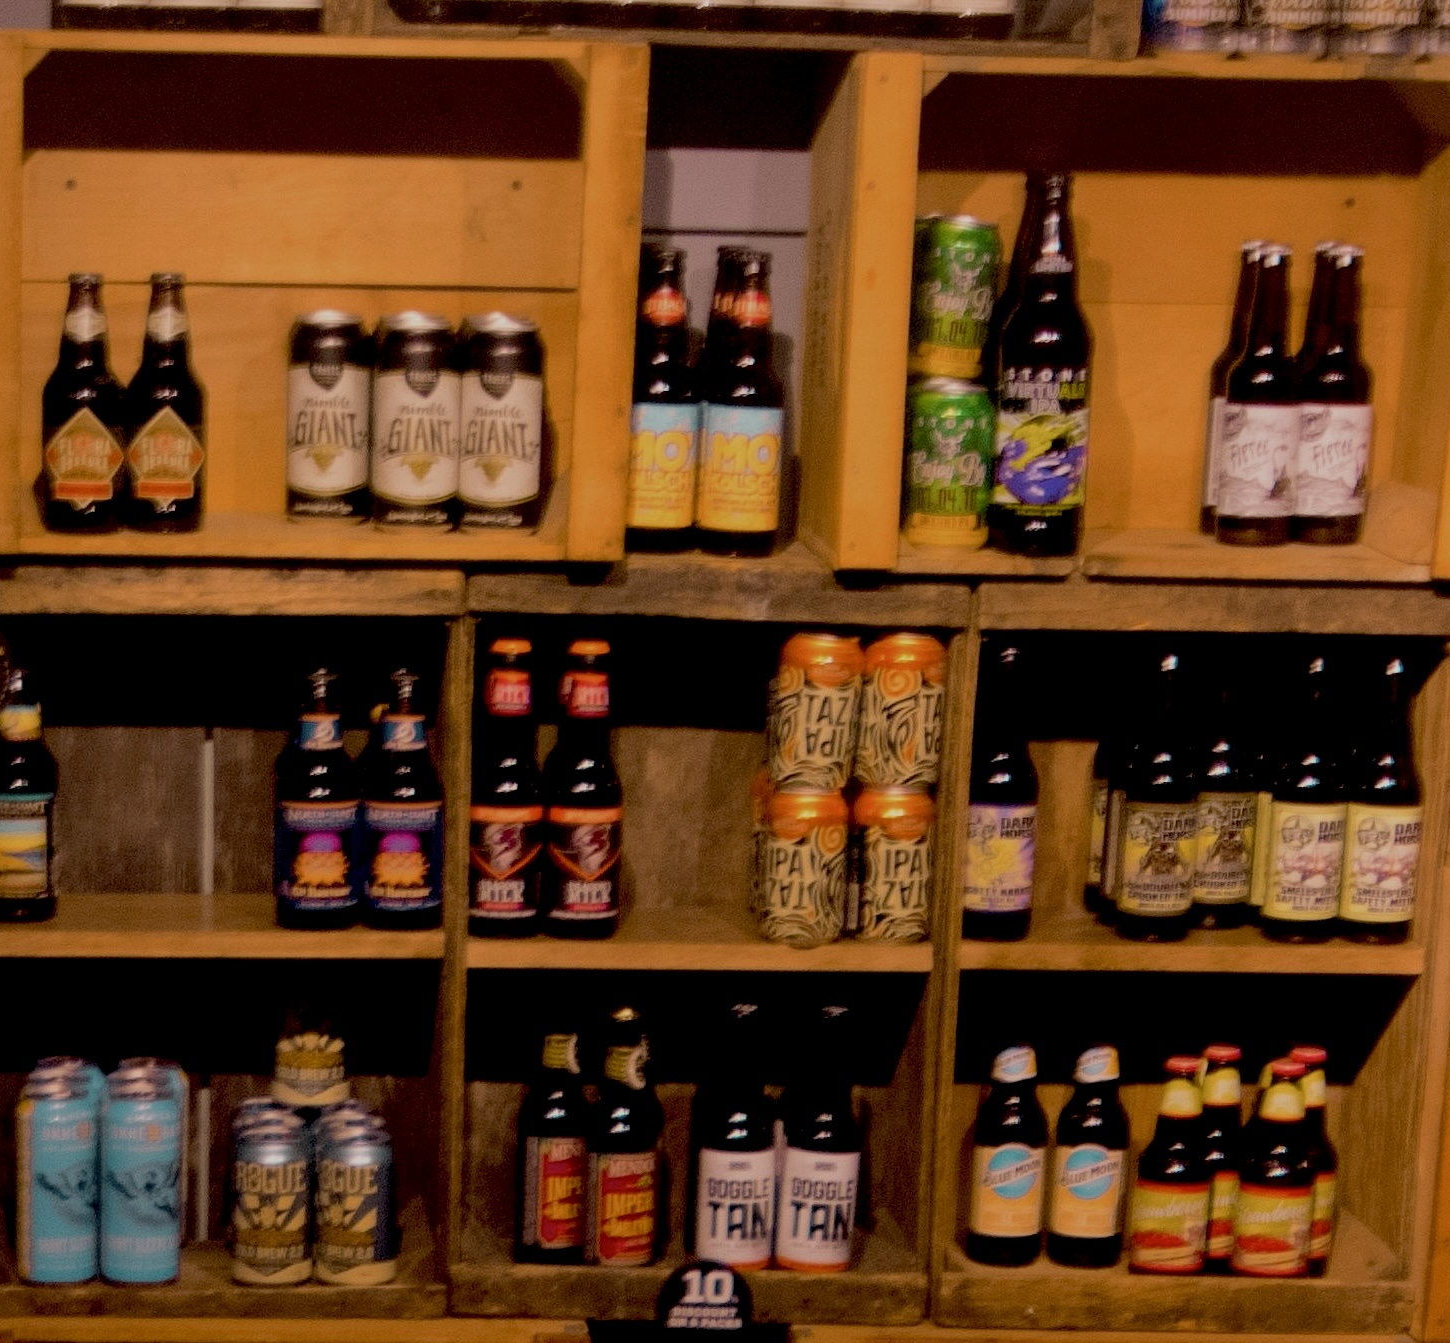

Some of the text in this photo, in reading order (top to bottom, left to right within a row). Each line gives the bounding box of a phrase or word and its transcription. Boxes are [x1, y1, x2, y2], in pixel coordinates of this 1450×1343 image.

[294, 409, 358, 450] GIANT
[465, 418, 529, 459] GIANT
[882, 847, 926, 881] IPA
[708, 1177, 771, 1200] GOGGLE
[792, 1177, 856, 1201] GOGGLE
[708, 1201, 769, 1241] TAN
[791, 1201, 853, 1241] TAN
